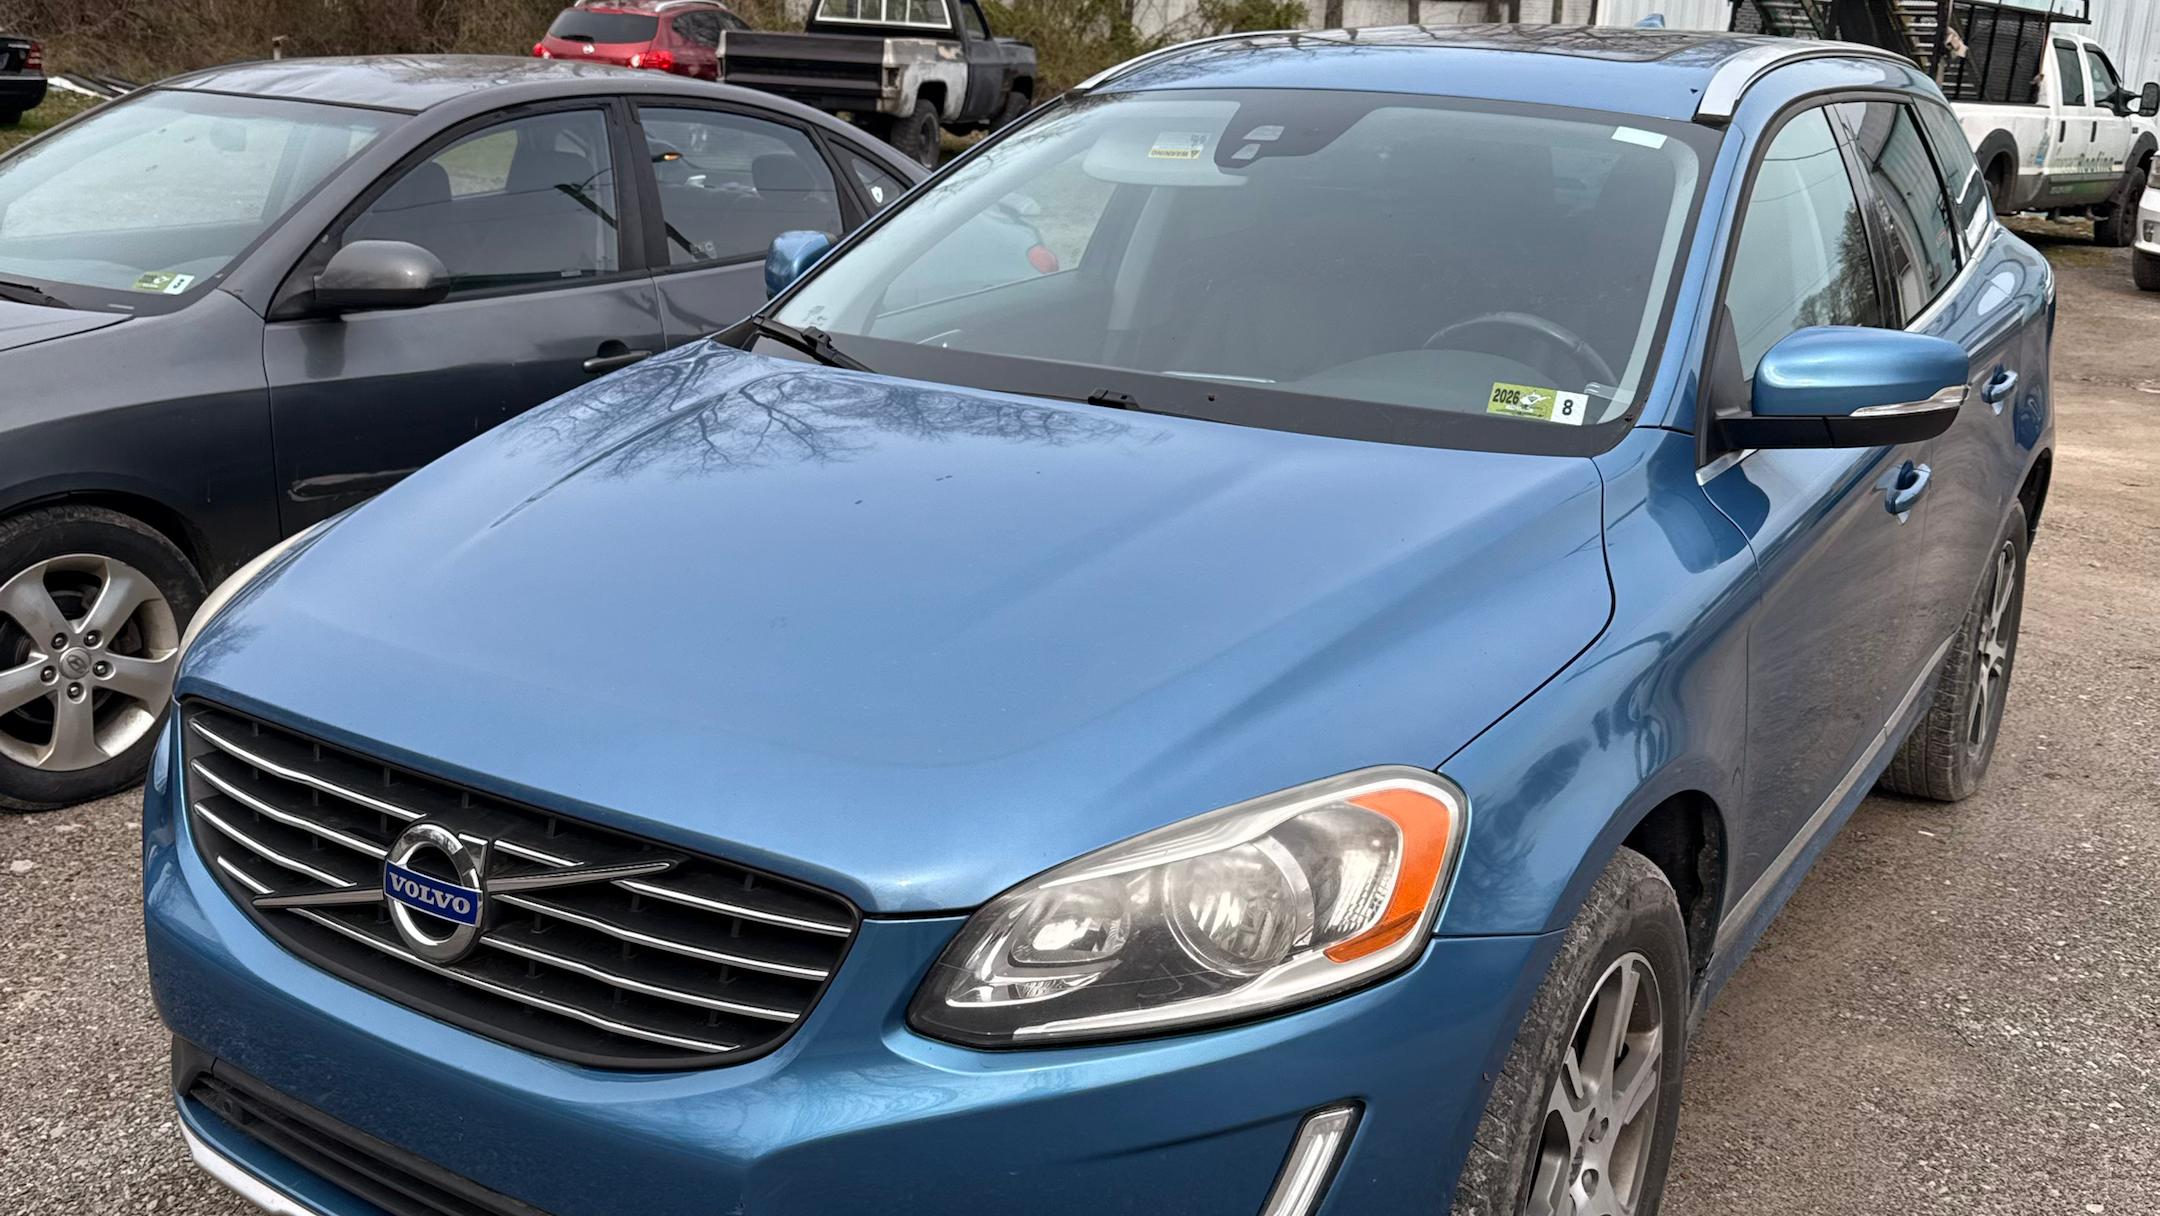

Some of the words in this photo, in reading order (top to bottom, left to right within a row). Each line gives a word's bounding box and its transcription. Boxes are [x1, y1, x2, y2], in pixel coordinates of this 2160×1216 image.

[1492, 388, 1520, 405] 2026
[1562, 399, 1574, 416] 8
[389, 871, 471, 915] VOLVO
